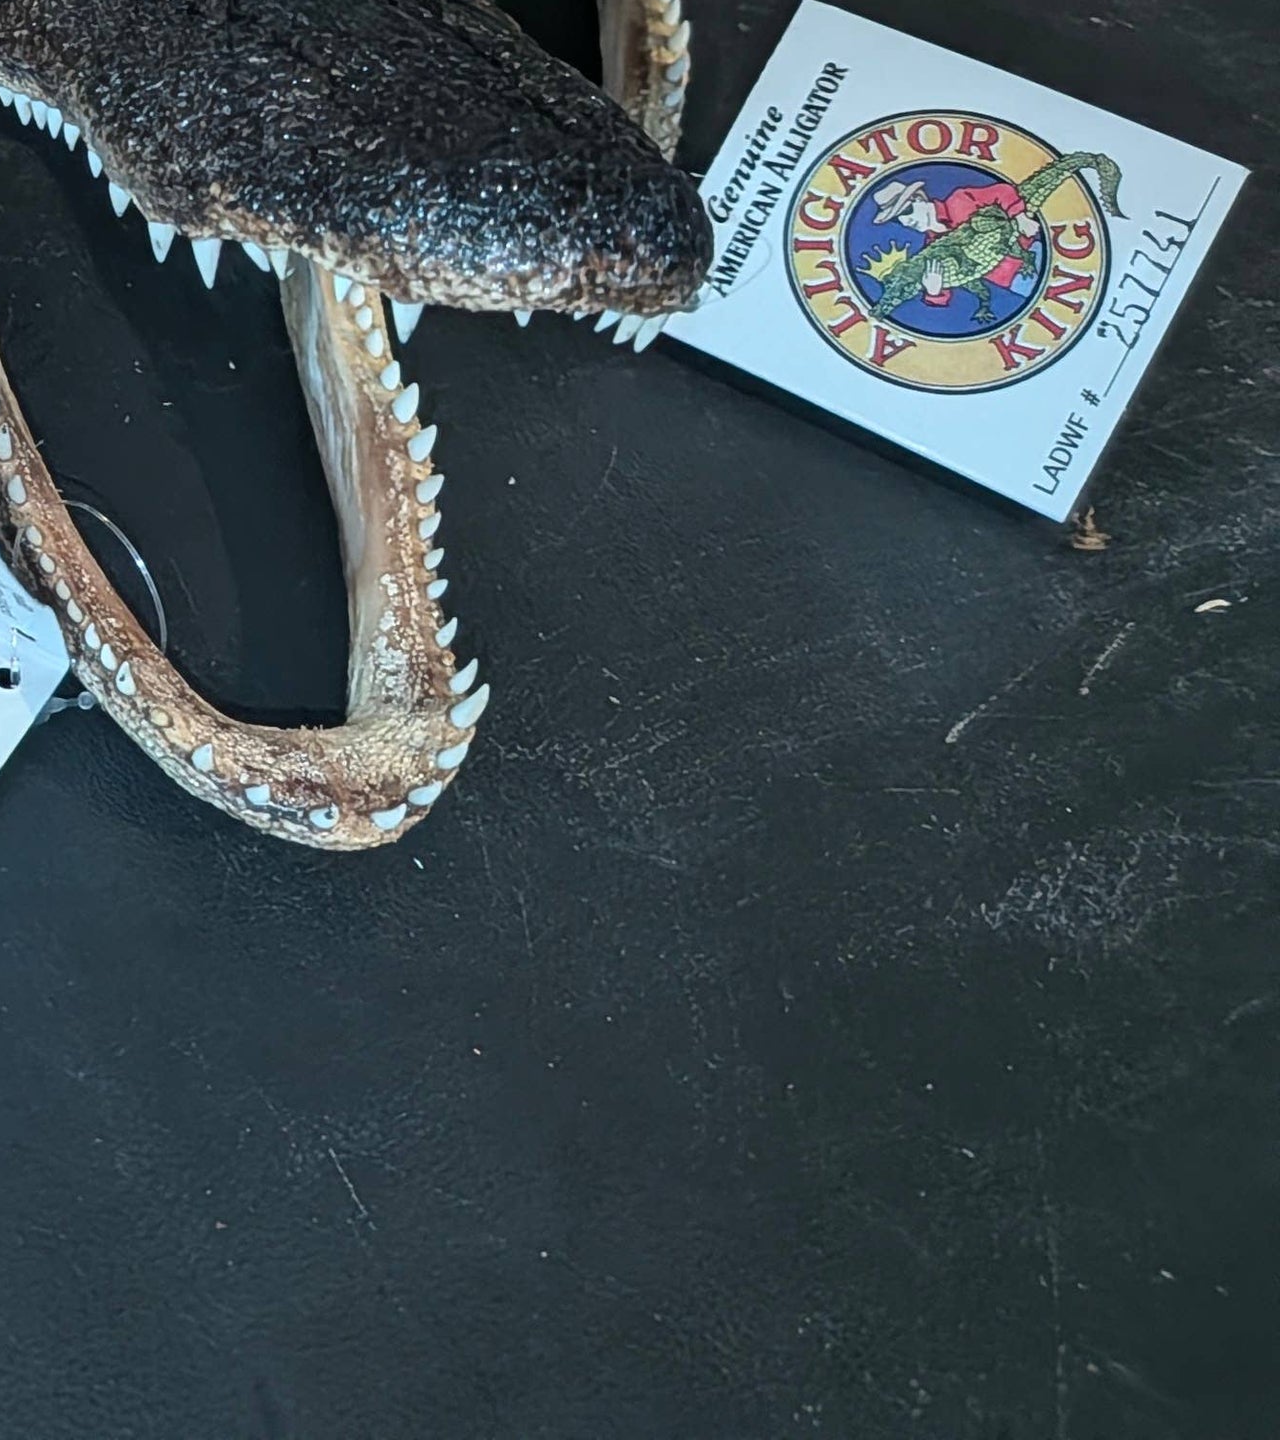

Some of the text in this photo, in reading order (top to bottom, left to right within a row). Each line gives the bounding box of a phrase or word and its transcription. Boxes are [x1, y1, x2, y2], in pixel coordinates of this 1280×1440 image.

[708, 104, 784, 225] Genuine
[712, 61, 848, 298] AMERICAN ALLIGATOR
[793, 120, 1001, 368] ALLIGATOR
[987, 220, 1095, 372] KING
[1033, 413, 1090, 495] LADWF
[1097, 210, 1197, 349] 257741
